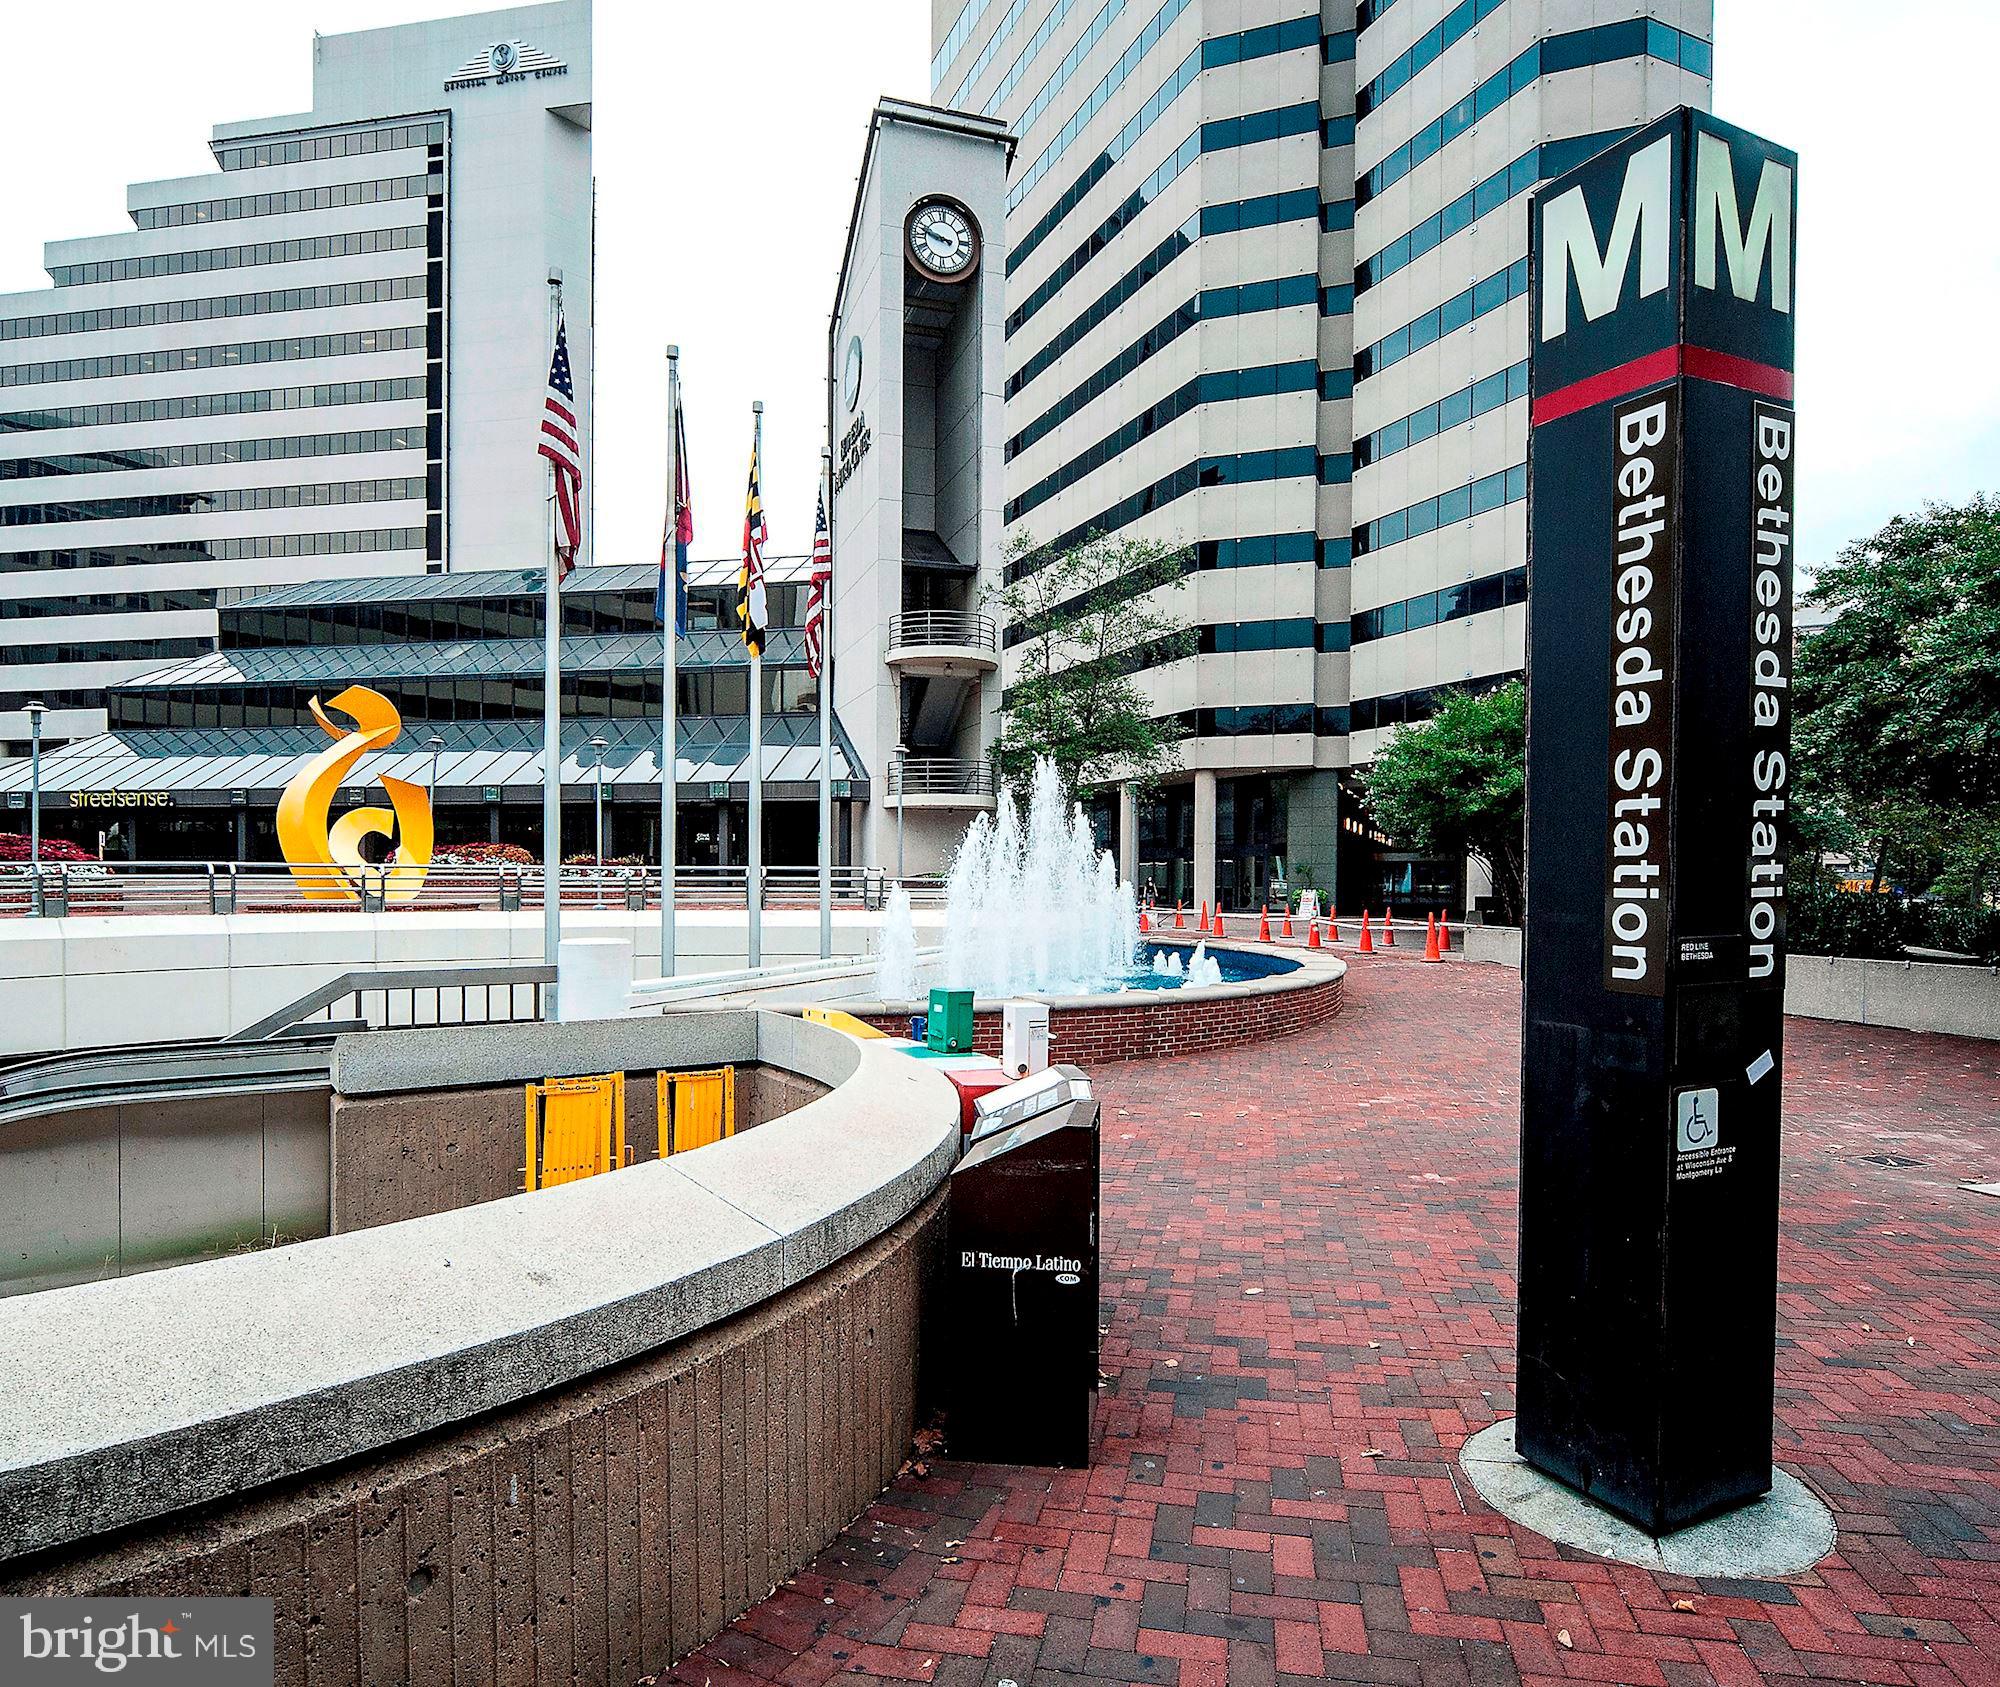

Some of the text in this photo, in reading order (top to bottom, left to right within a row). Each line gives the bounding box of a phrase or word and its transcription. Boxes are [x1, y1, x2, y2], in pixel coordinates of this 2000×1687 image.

[1694, 130, 1792, 314] M
[1541, 133, 1672, 343] M
[1611, 401, 1667, 980] Bethesda Station
[1748, 415, 1791, 978] Bethesda Station
[1680, 942, 1709, 951] RED LINE
[1680, 951, 1714, 960] BETHESDA
[1677, 1146, 1737, 1161] Accessible Entrance
[1676, 1166, 1723, 1180] Montgomery La
[1685, 1159, 1715, 1170] Wisconsin
[961, 1251, 1081, 1273] El Tiempo Latino
